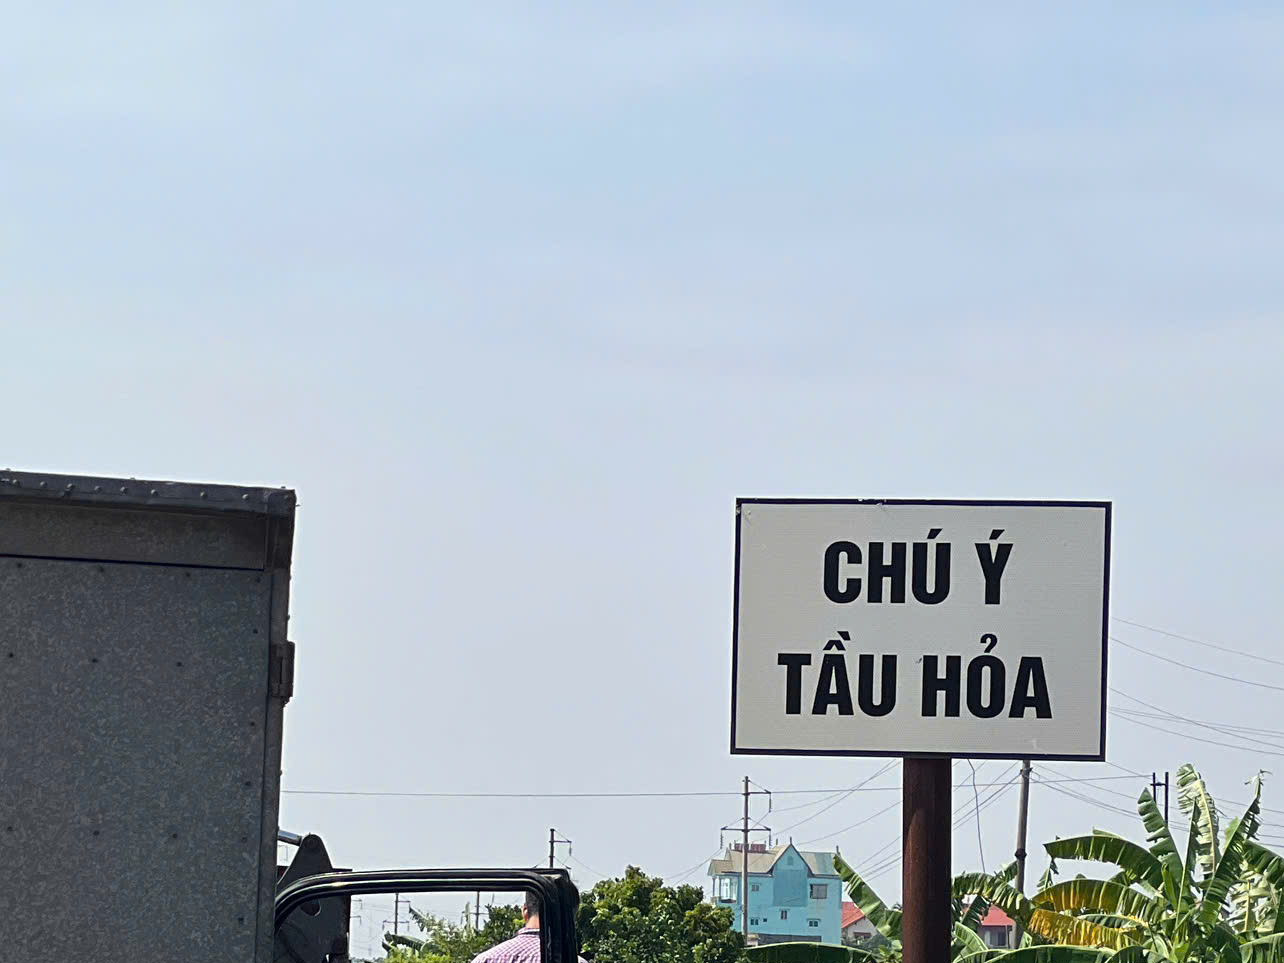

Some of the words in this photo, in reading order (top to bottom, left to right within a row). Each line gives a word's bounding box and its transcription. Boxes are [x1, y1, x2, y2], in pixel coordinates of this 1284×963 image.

[823, 528, 952, 605] CHÚ
[974, 528, 1014, 605] Ý
[777, 630, 898, 717] TẦU
[920, 633, 1053, 719] HỎA
